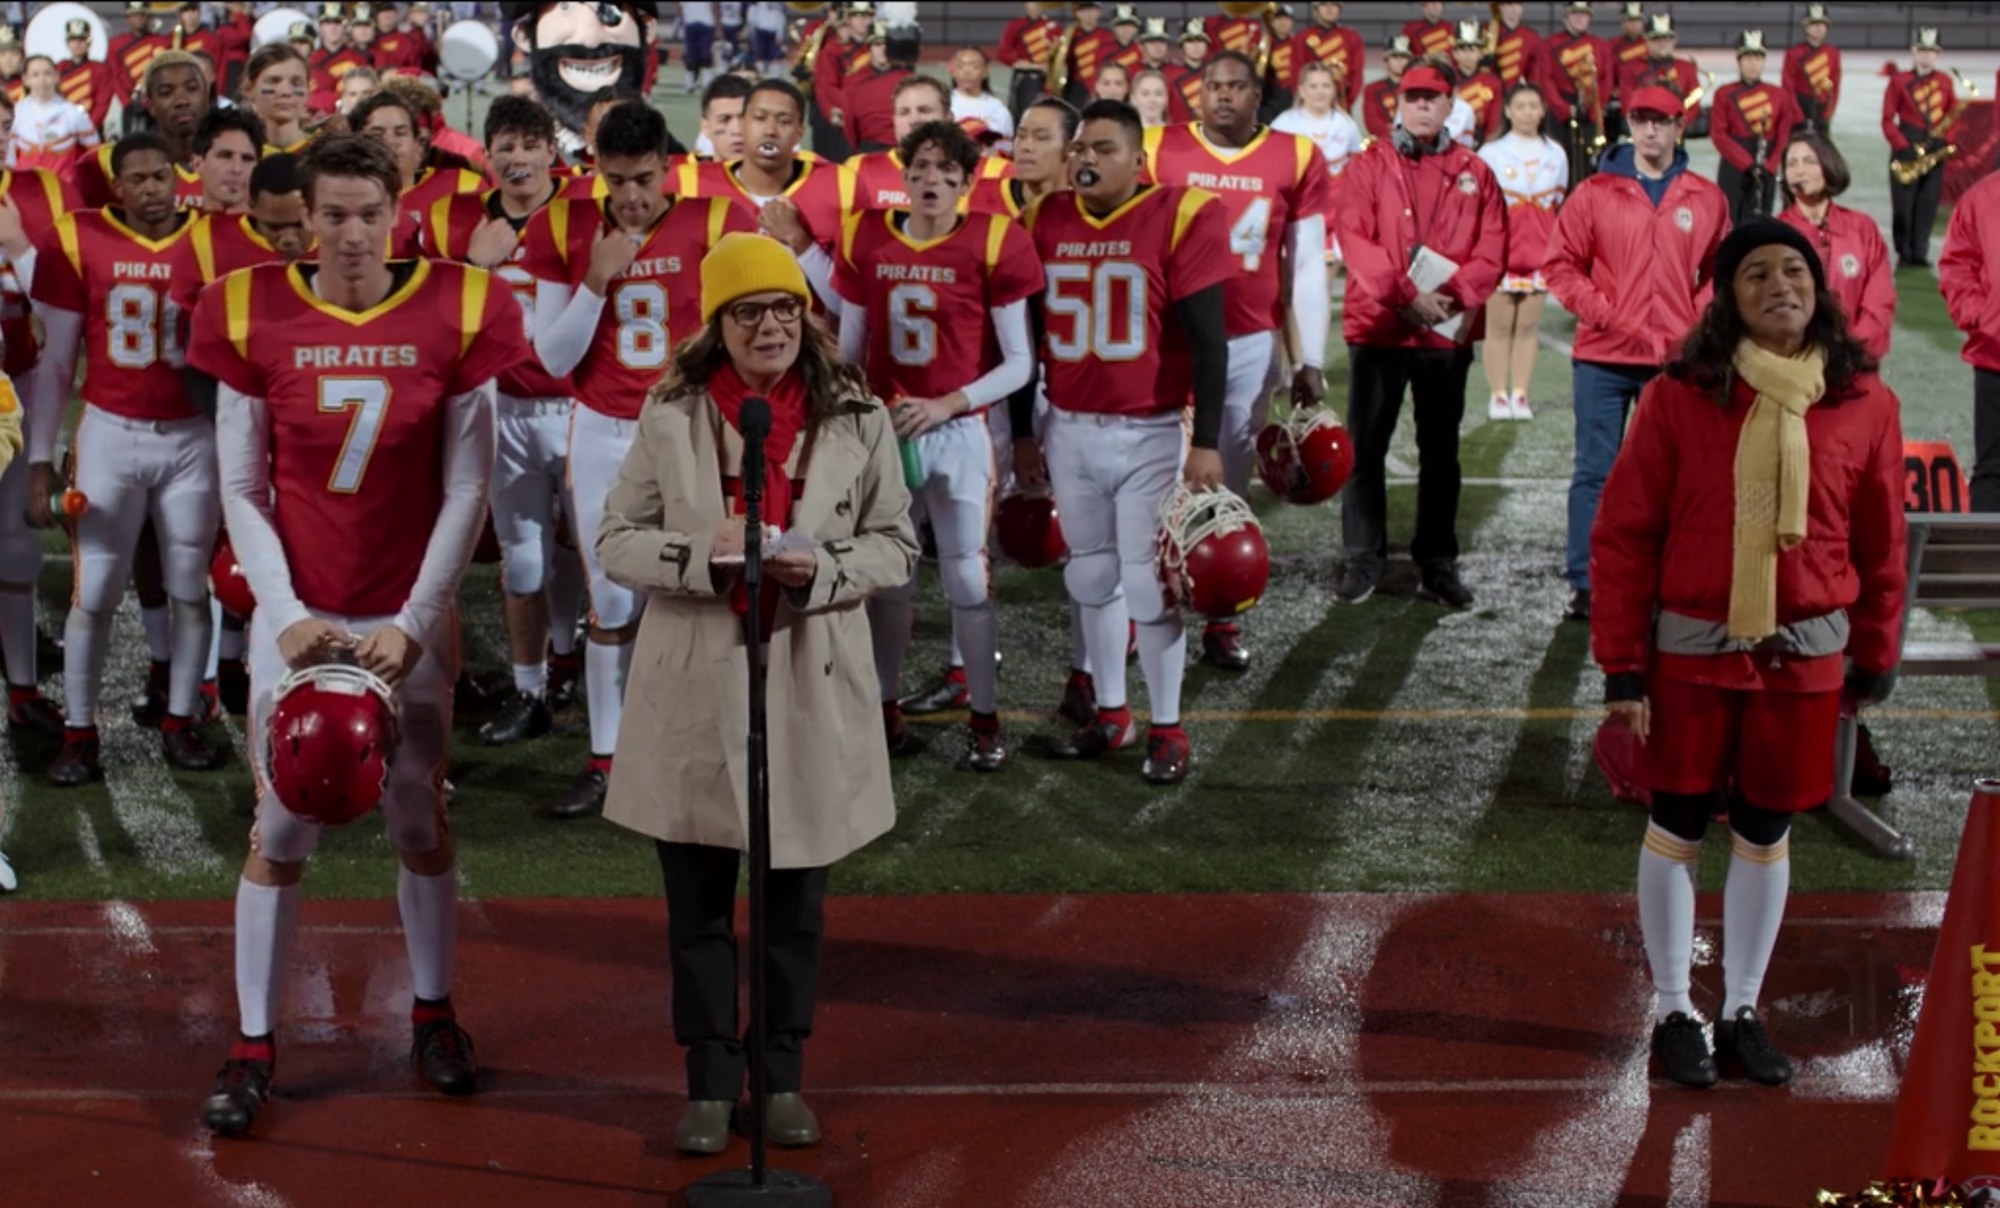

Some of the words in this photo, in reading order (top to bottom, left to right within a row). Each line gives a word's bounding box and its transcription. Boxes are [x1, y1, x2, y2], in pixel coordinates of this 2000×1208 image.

[1187, 172, 1263, 192] PIRATES
[619, 256, 682, 279] ATES
[1056, 240, 1132, 257] PIRATES
[1229, 197, 1273, 272] 4
[875, 263, 956, 284] PIRATES
[614, 279, 670, 370] 8
[888, 282, 938, 367] 6
[1044, 259, 1148, 362] 50
[293, 343, 418, 369] PIRATES
[317, 374, 394, 494] 7
[1904, 455, 1960, 513] 30
[1966, 943, 2000, 1151] ROCKPORT
